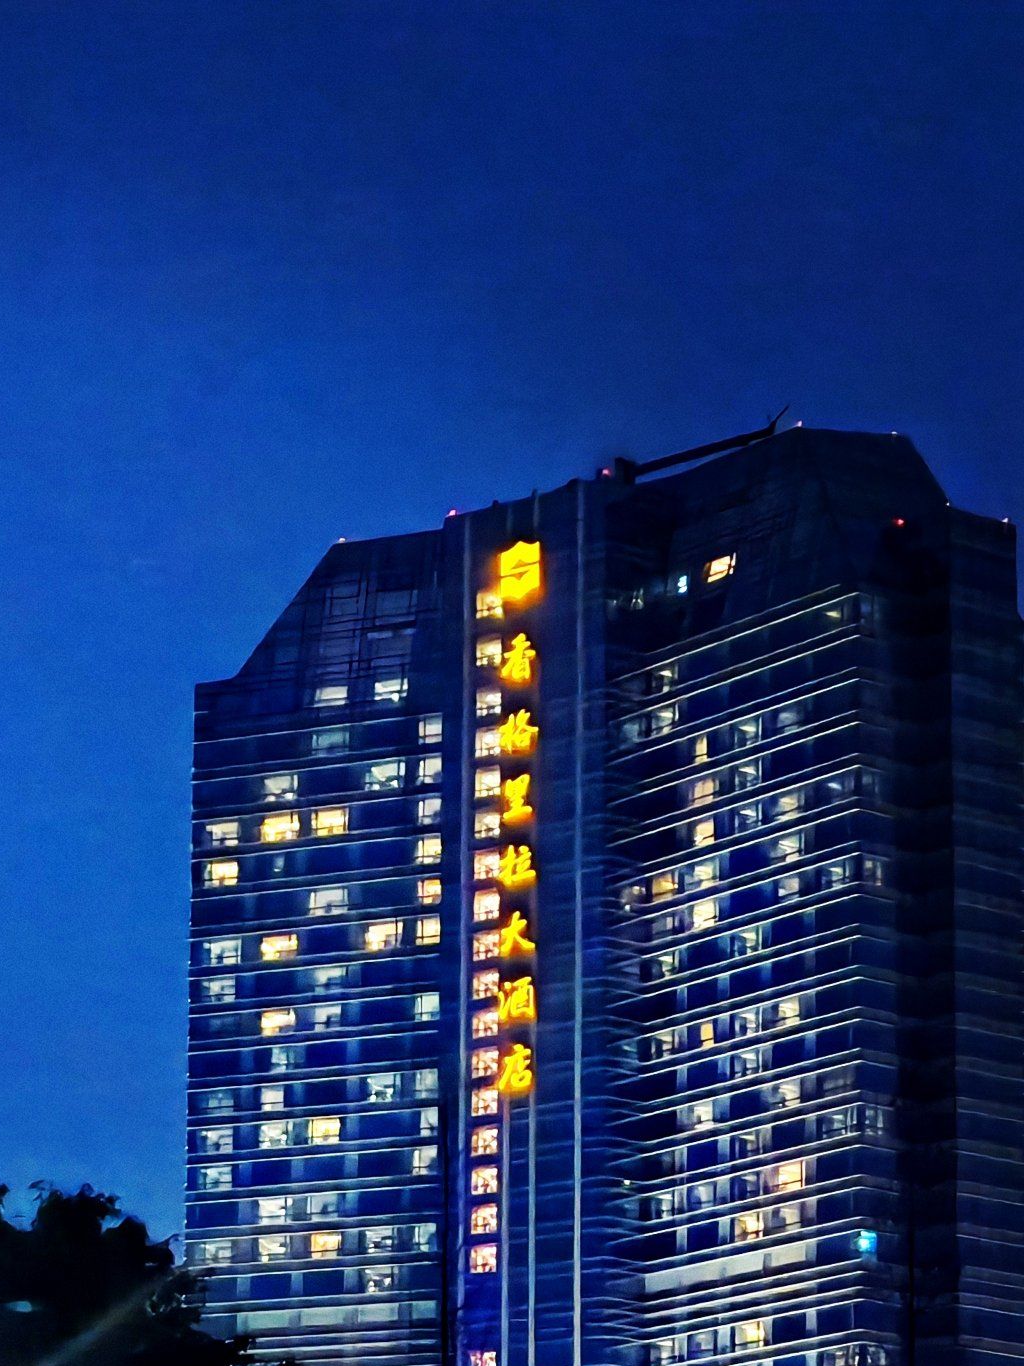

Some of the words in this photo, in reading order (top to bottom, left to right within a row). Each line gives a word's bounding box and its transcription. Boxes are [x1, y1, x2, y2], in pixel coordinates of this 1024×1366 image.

[498, 633, 538, 1091] 香格里拉大酒店
